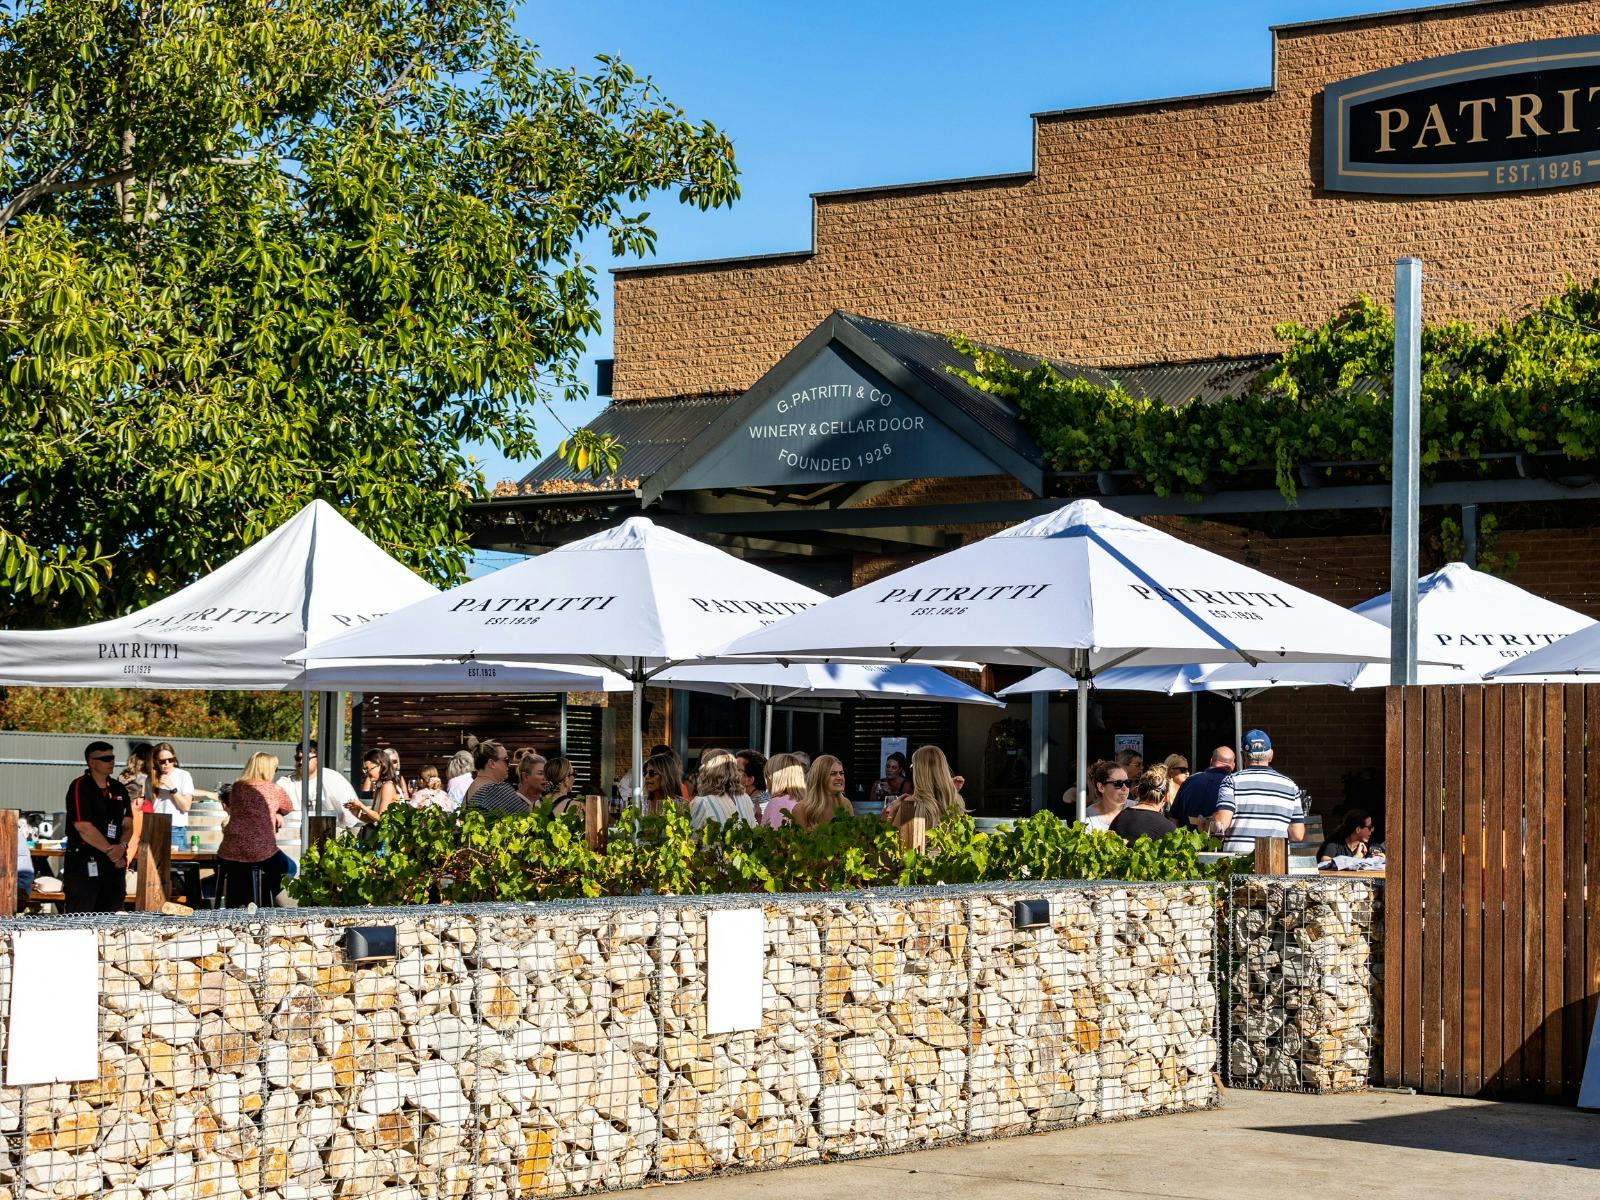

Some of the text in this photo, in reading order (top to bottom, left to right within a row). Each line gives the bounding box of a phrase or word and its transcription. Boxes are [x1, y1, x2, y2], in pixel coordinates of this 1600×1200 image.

[1496, 160, 1581, 184] EST.1926
[856, 386, 865, 399] &
[870, 388, 892, 406] CO
[879, 416, 924, 432] DOOR
[778, 443, 892, 472] FOUNDED 1926
[876, 584, 1052, 604] PATRITTI
[1128, 584, 1295, 608] PATRITTI
[448, 596, 619, 613] PATRITTI
[688, 598, 817, 615] PATRITT
[910, 607, 969, 616] EST.1926
[133, 607, 293, 629] PATRITTI
[484, 616, 541, 625] EST.1926
[1208, 609, 1263, 620] EST.1926
[98, 642, 179, 659] PATRITTI
[468, 668, 497, 677] EST.1926
